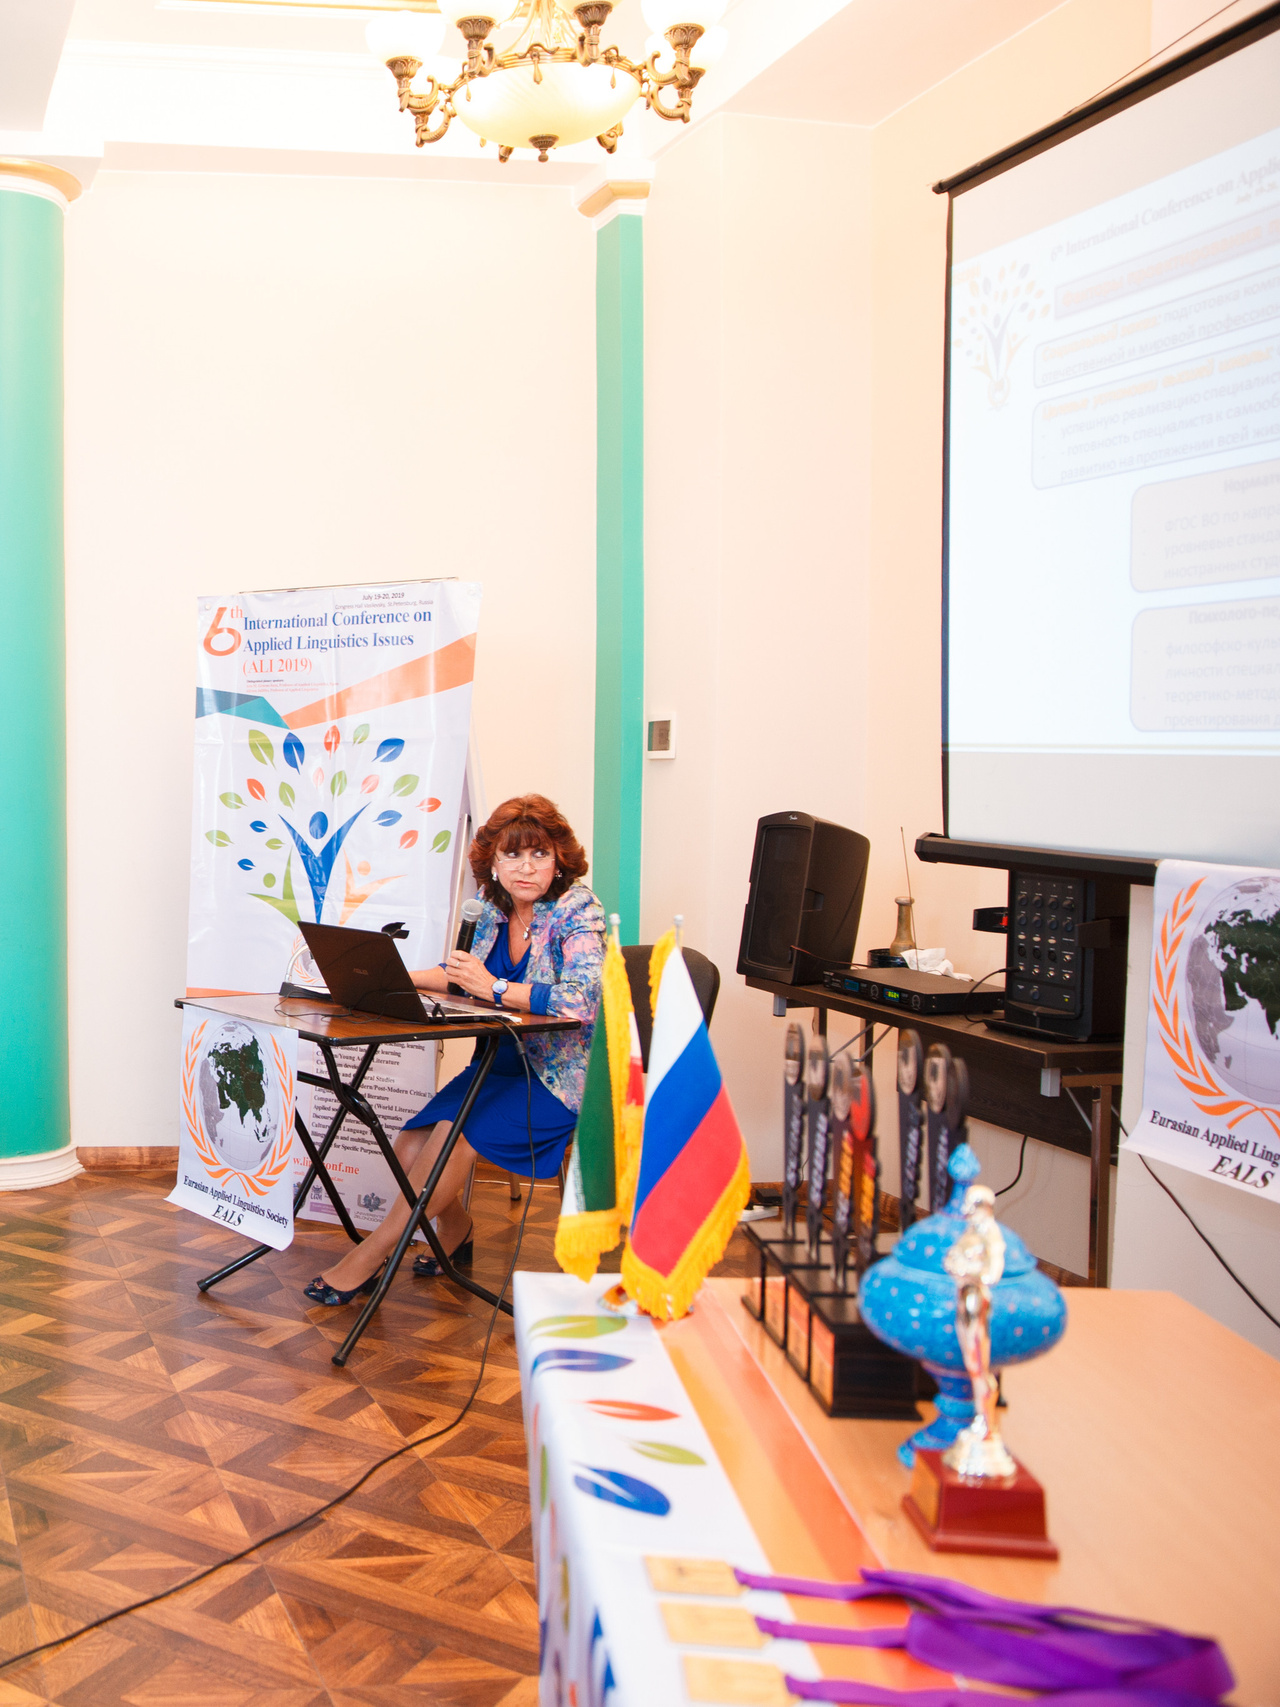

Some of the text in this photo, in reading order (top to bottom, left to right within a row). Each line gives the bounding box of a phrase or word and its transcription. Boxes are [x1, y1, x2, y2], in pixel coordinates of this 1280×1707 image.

[1066, 213, 1139, 256] International
[1141, 187, 1213, 226] Conference
[1217, 179, 1234, 198] on
[1163, 289, 1241, 322] подготовка
[1041, 347, 1126, 384] отечественной
[1139, 323, 1197, 354] мировой
[243, 612, 328, 631] International
[332, 610, 410, 627] Conference
[413, 611, 432, 623] on
[243, 632, 415, 656] Applied Linguistics Issues
[243, 656, 313, 678] (ALI 2019)
[381, 1050, 401, 1058] learning
[375, 1076, 395, 1084] Studies
[367, 1093, 389, 1102] literature
[409, 1089, 427, 1098] Critical
[313, 1104, 331, 1112] Applied
[374, 1103, 394, 1112] (World
[343, 1126, 369, 1136] Language
[1150, 1110, 1200, 1139] Eurasian
[1200, 1127, 1249, 1154] Applied
[341, 1144, 360, 1152] Specific
[1209, 1155, 1274, 1189] EALS
[183, 1175, 209, 1194] Eurasian
[209, 1187, 233, 1202] Applied
[232, 1195, 266, 1217] Linguistics
[265, 1208, 289, 1229] Society
[211, 1204, 245, 1227] EALS
